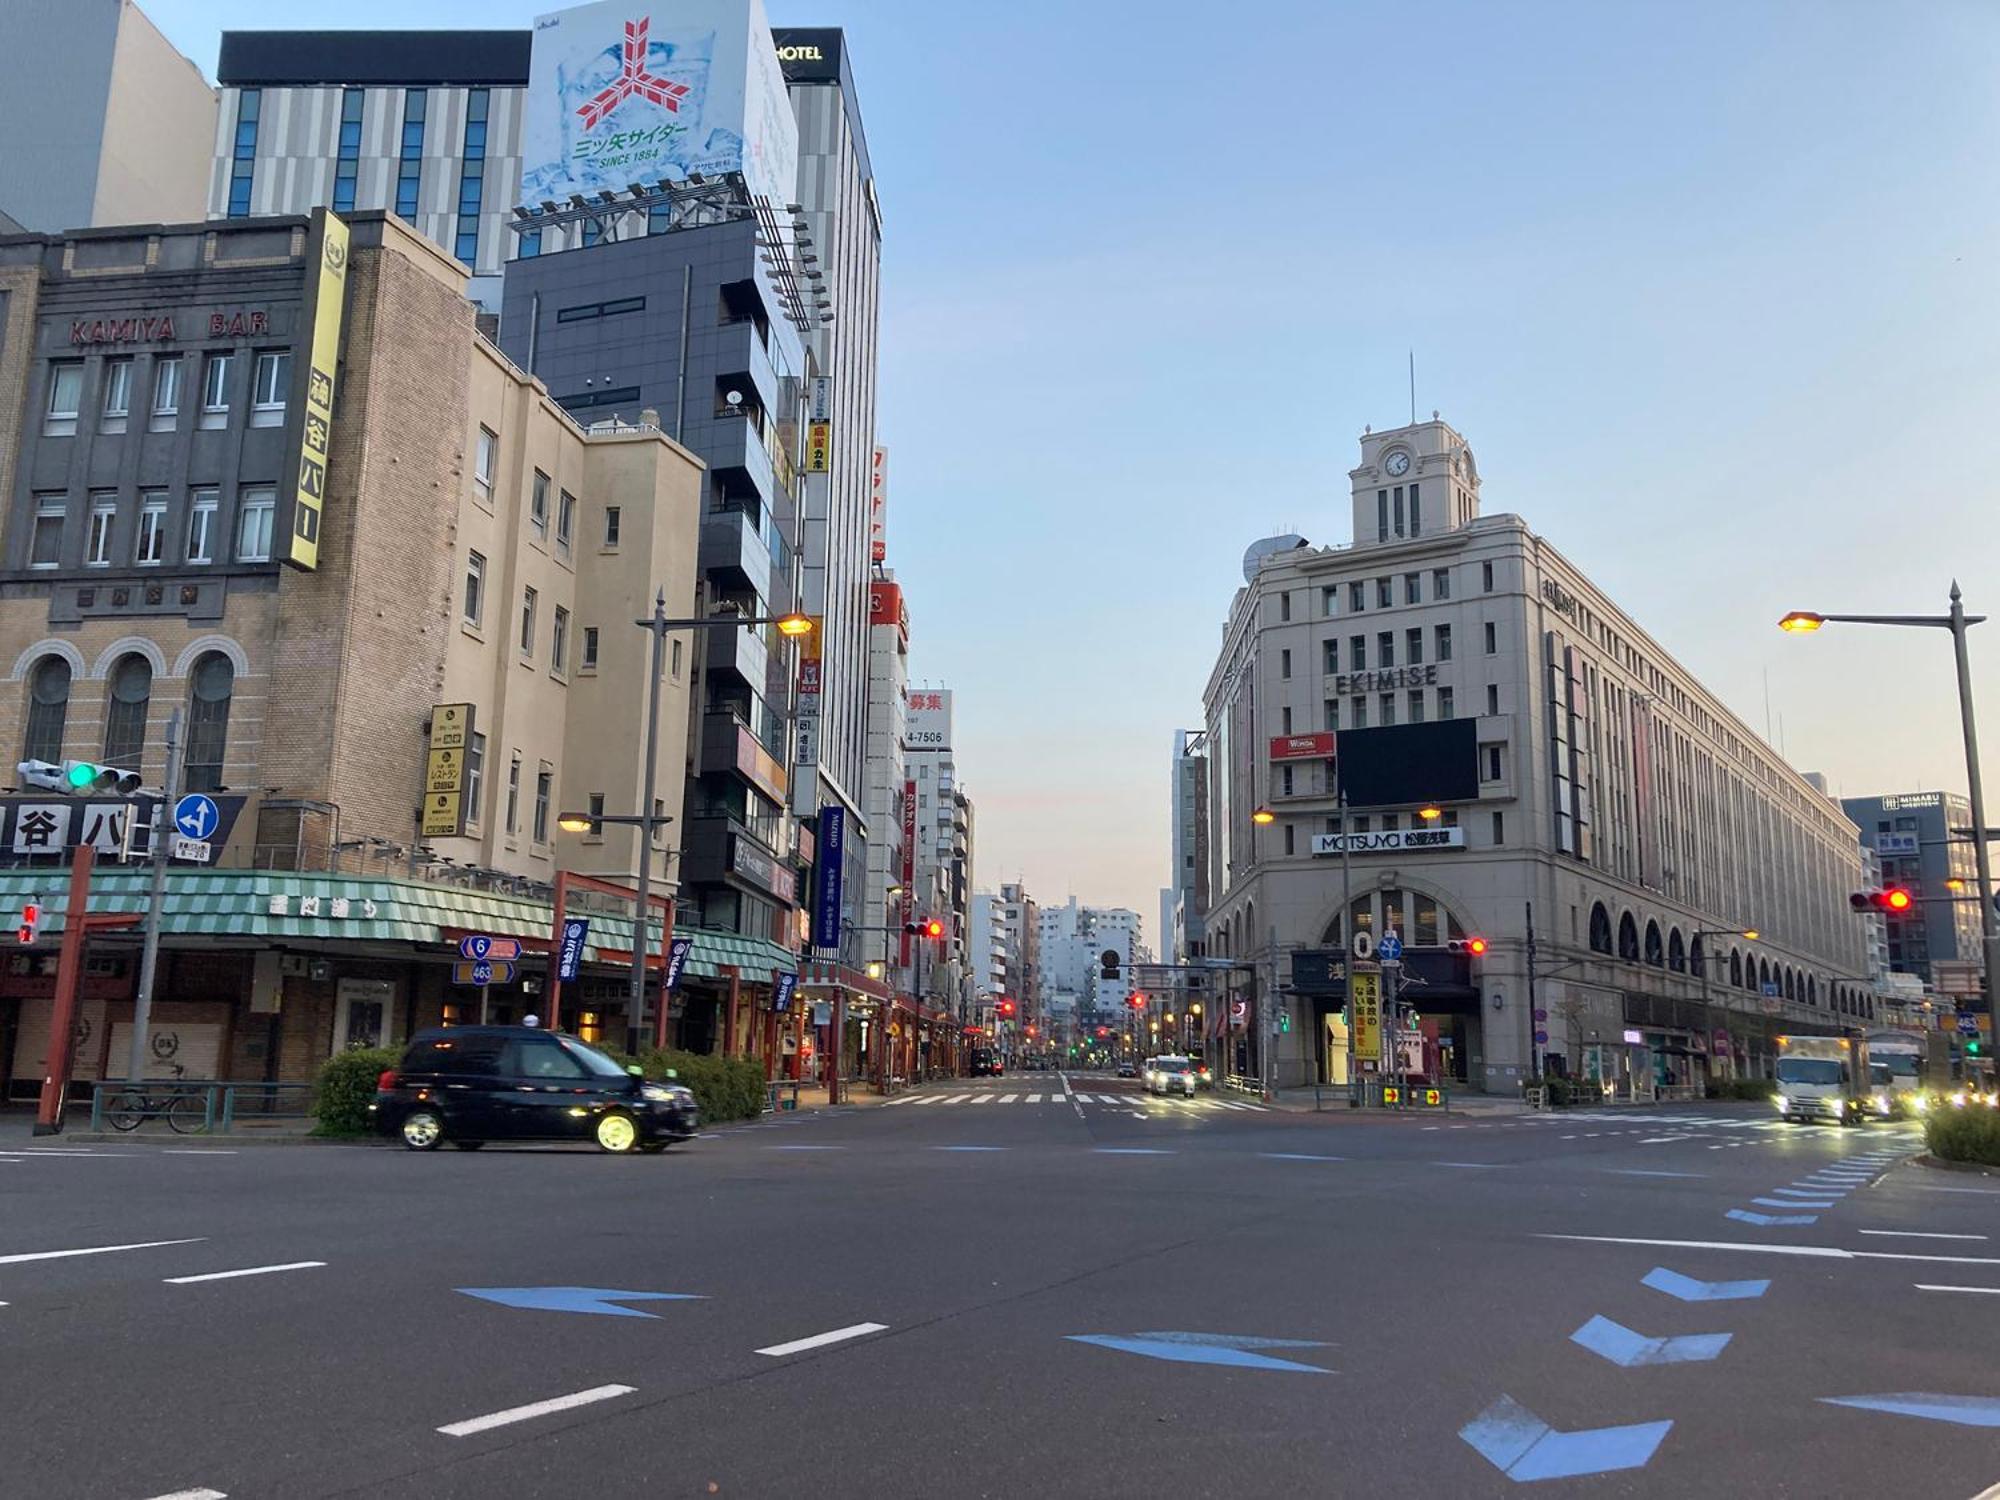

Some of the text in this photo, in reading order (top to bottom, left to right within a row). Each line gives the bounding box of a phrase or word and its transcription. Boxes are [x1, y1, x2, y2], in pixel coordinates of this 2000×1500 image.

[777, 46, 822, 60] HOTEL
[572, 121, 688, 160] 三ツ矢サイダー
[599, 148, 659, 169] SINCE 1884
[71, 311, 268, 343] KAMIYA BAR
[299, 370, 331, 538] 神谷バー
[1336, 665, 1437, 695] EKIMISE
[909, 694, 943, 710] 募集
[831, 814, 840, 848] MIZUHO
[477, 939, 485, 953] 6
[473, 966, 491, 979] 463
